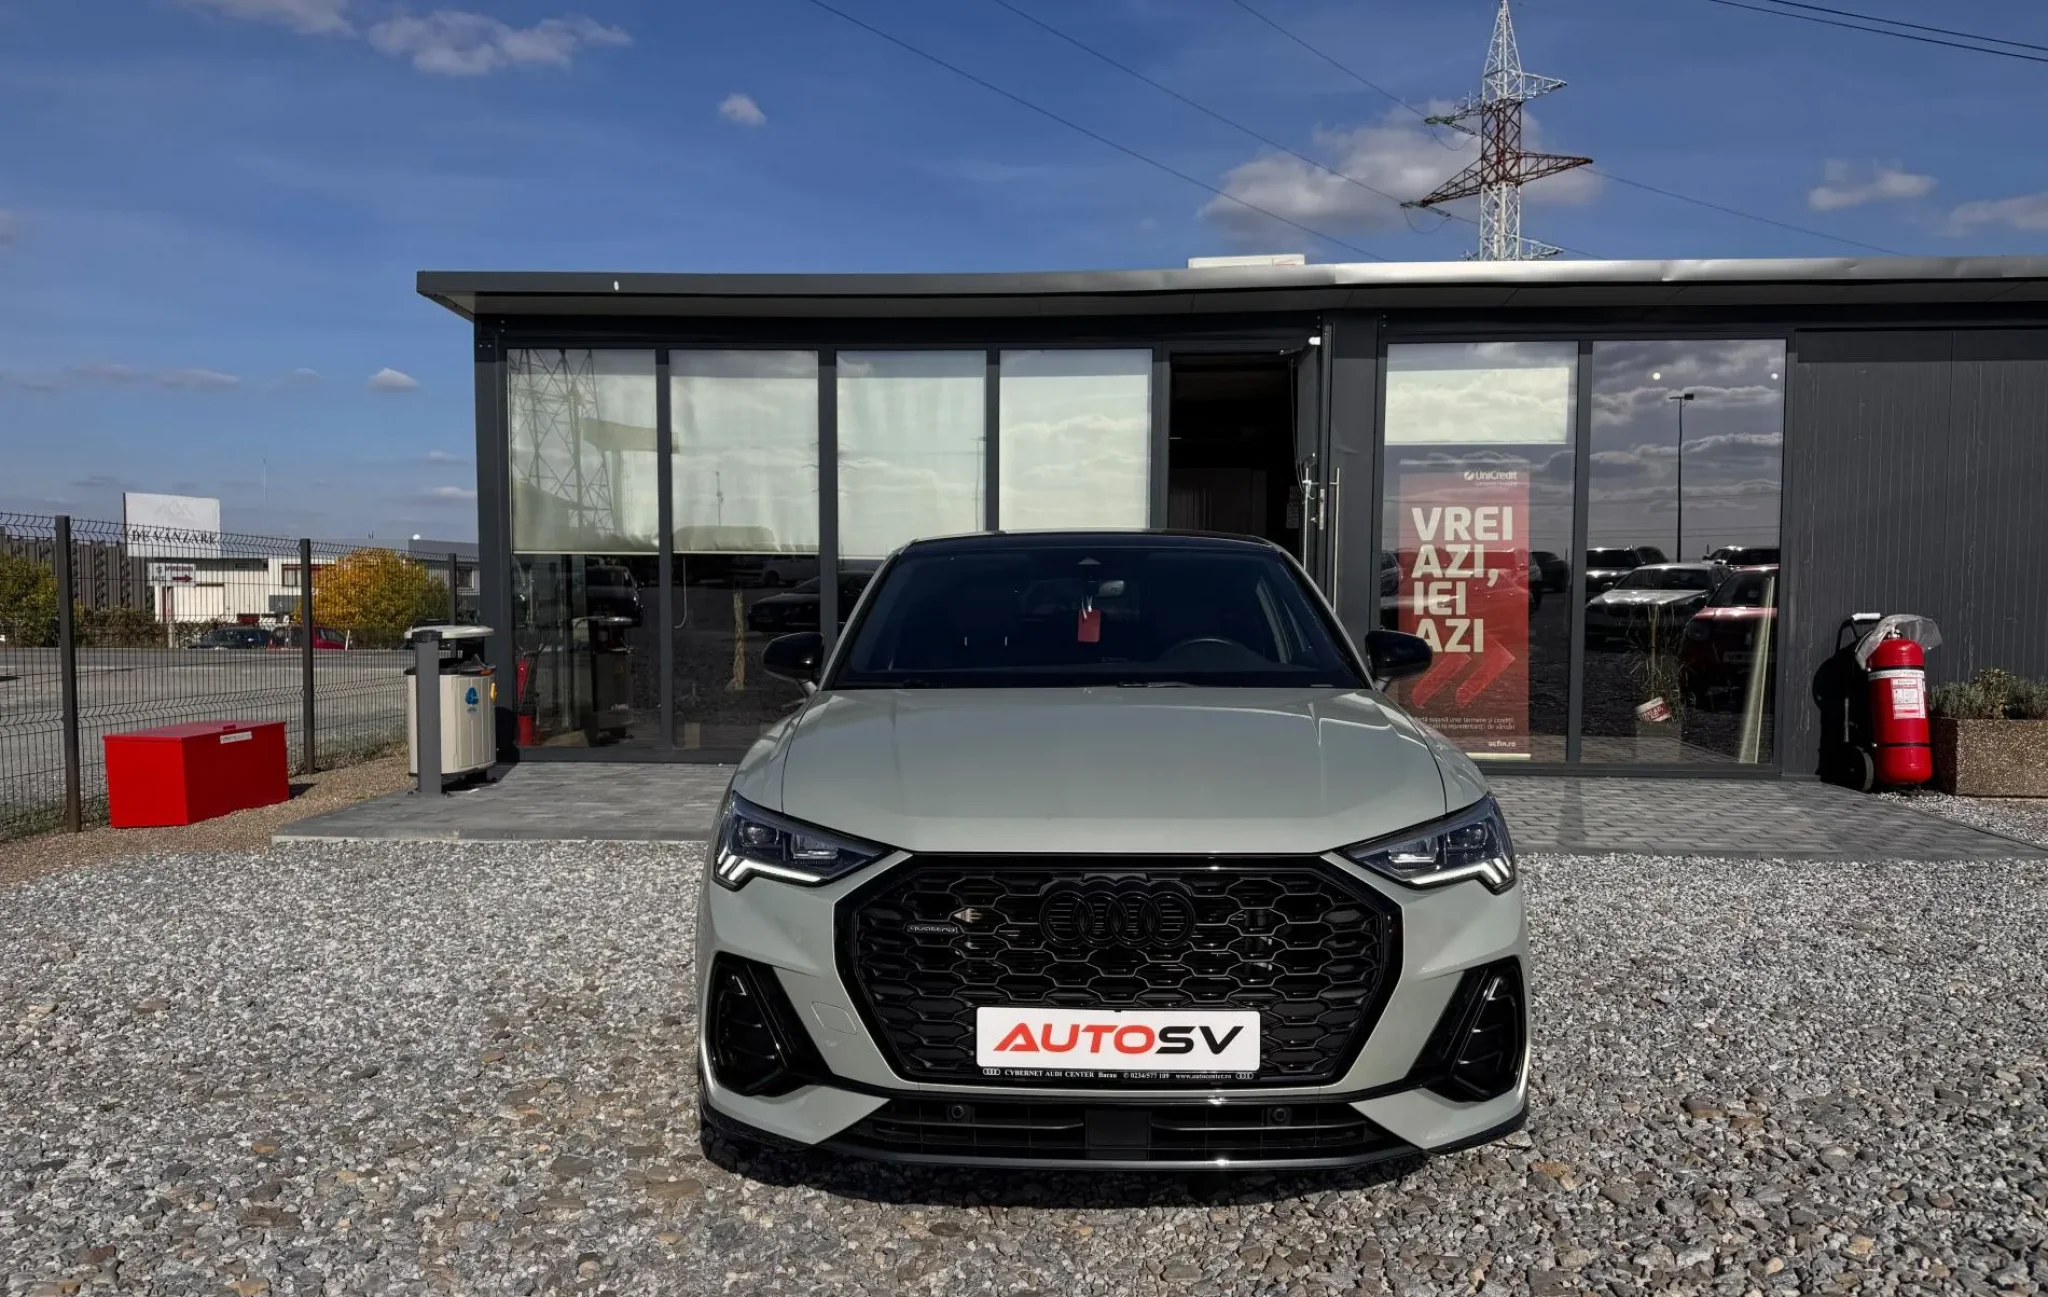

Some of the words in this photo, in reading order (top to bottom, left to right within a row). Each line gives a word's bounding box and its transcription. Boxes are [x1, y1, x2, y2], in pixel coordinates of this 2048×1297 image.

[1476, 470, 1517, 480] UniCredit
[1412, 506, 1513, 541] VREI
[1412, 544, 1499, 587] AZI,
[1414, 581, 1467, 615] IEI
[1415, 618, 1484, 653] AZI
[993, 1022, 1244, 1055] AUTOSV
[1005, 1069, 1042, 1077] CYBERNET
